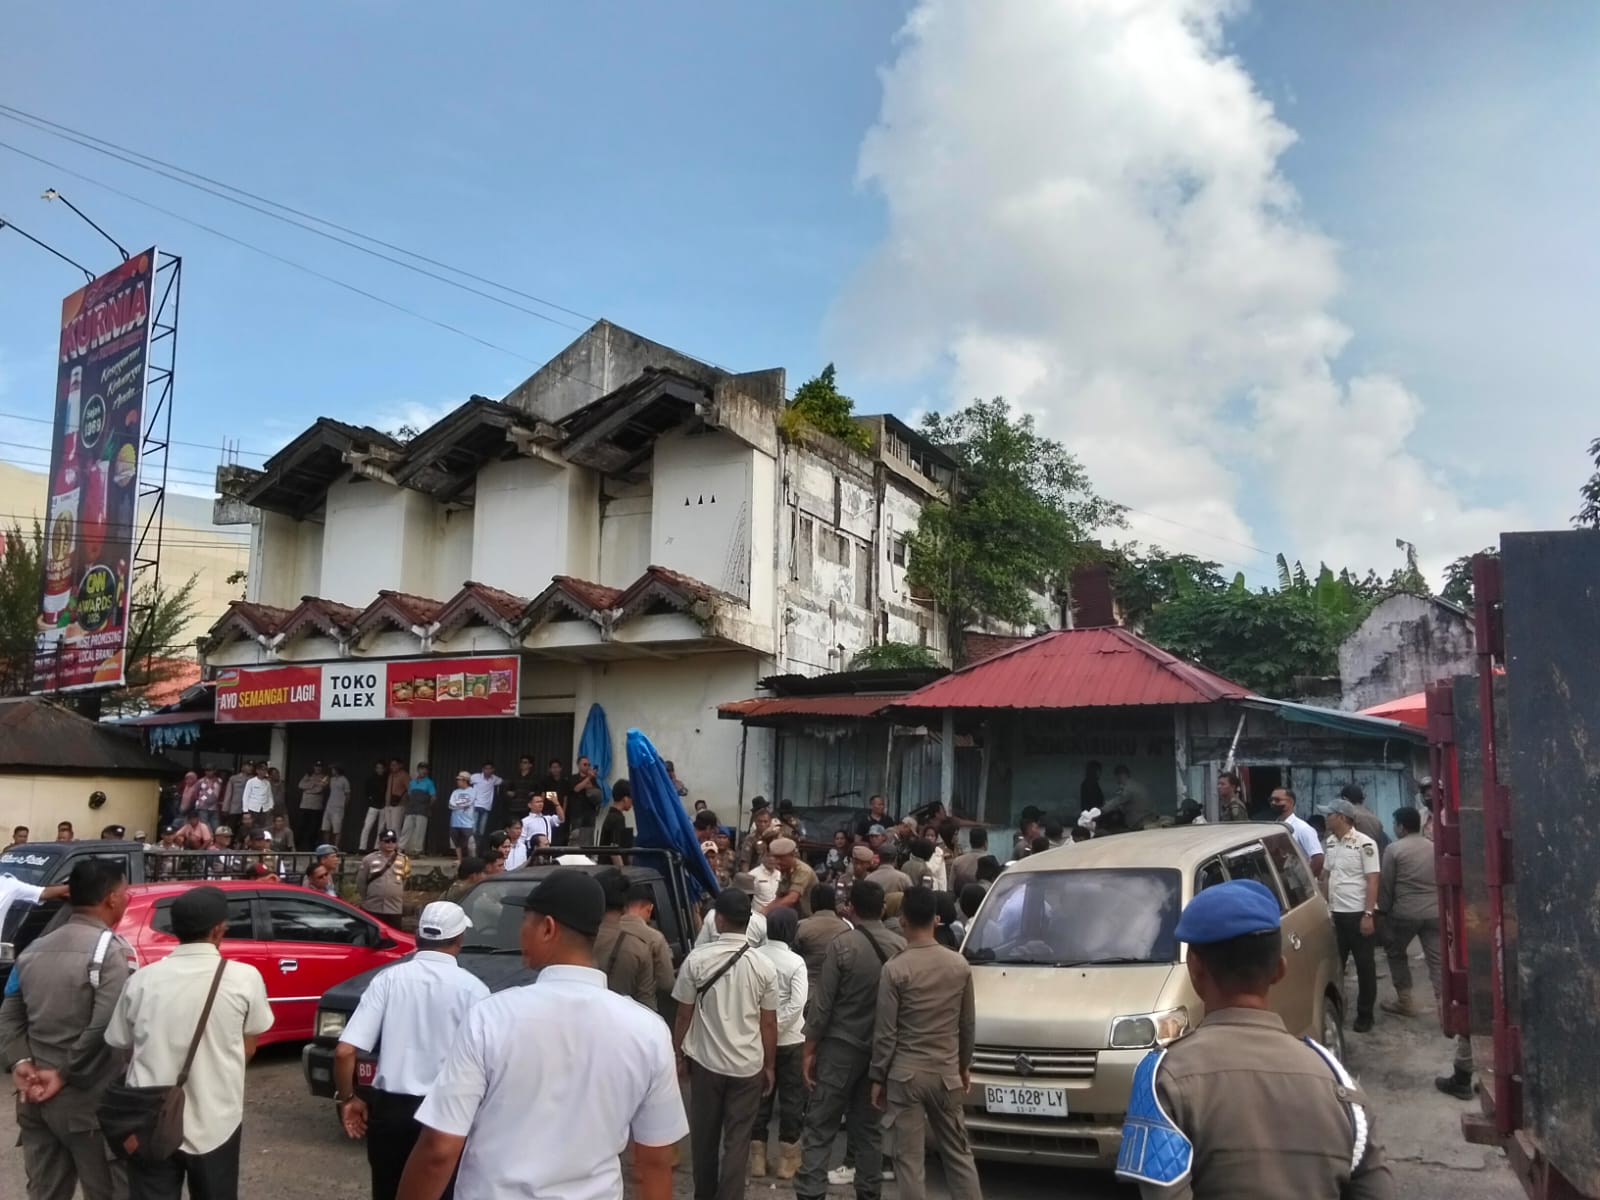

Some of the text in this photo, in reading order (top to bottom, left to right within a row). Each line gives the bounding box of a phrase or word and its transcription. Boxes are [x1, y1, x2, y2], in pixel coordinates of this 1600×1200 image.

[61, 281, 147, 363] KURNIA
[84, 418, 102, 437] 1969
[79, 595, 113, 612] AWARDS
[90, 630, 122, 646] PROMISING
[78, 650, 95, 663] LOCAL
[330, 674, 377, 691] TOKO
[220, 683, 316, 710] AYO SEMANGAT LAGI!
[331, 692, 376, 708] ALEX
[359, 1063, 372, 1077] BD
[987, 1087, 1063, 1108] BG 1628 LY
